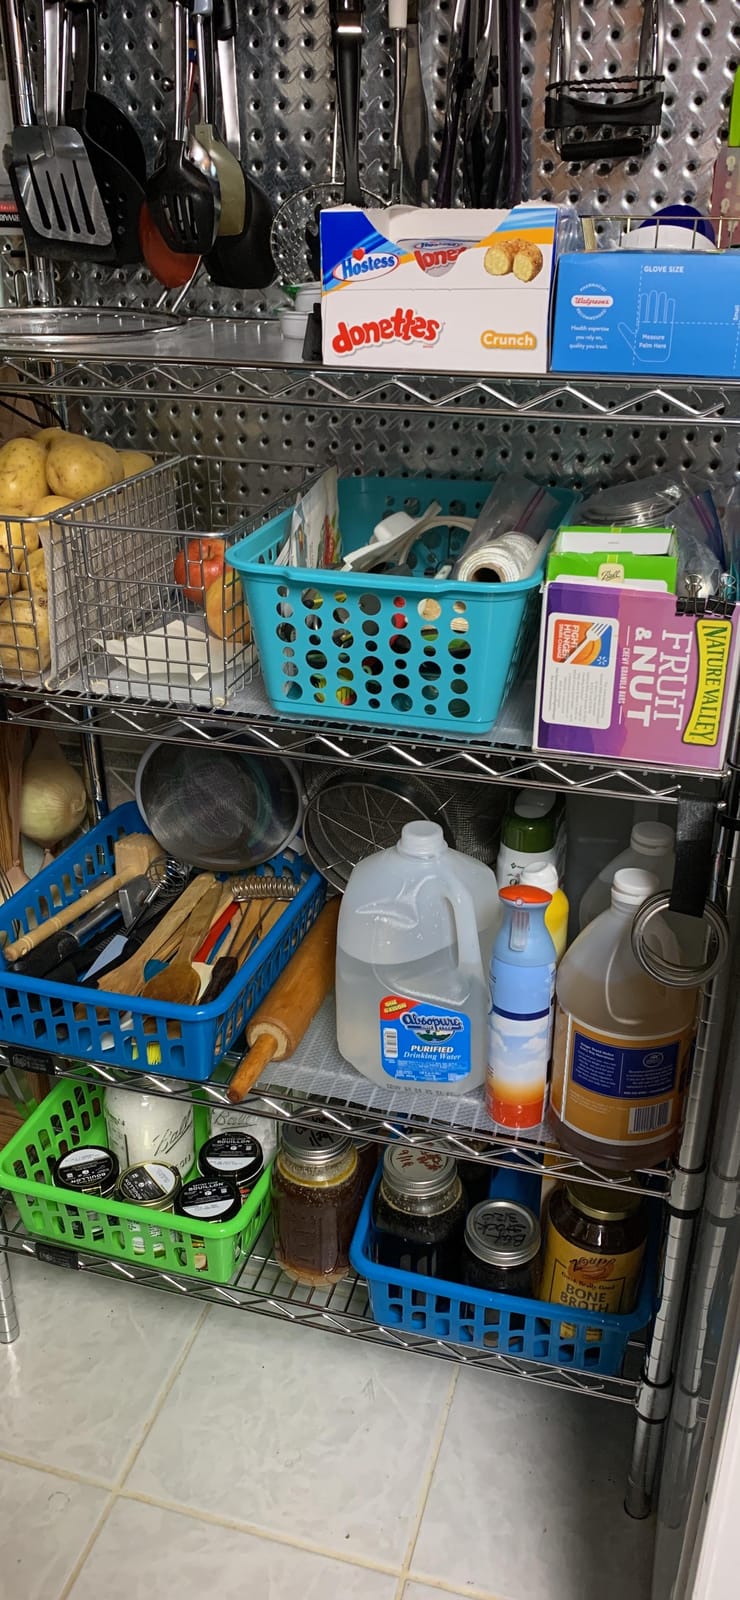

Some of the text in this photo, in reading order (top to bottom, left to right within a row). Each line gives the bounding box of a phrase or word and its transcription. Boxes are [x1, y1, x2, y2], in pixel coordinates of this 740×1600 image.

[342, 256, 396, 280] Hostess
[644, 265, 667, 273] GLOVE
[575, 297, 610, 306] Walgreens
[332, 308, 440, 354] donettes
[483, 333, 534, 346] Crunch
[642, 333, 666, 341] Measure
[601, 569, 621, 581] Ball
[571, 624, 580, 648] FIGHT
[618, 647, 630, 705] CHEWY GRANOLA BARS
[627, 627, 658, 727] & NUT
[653, 629, 693, 731] FRUIT
[689, 625, 728, 742] NATURE VALLEY
[401, 1013, 463, 1032] Absopure
[404, 1052, 462, 1061] Drinking Water
[411, 1045, 454, 1054] PURIFIED
[561, 1291, 609, 1312] BROTH
[566, 1283, 607, 1303] BONE
